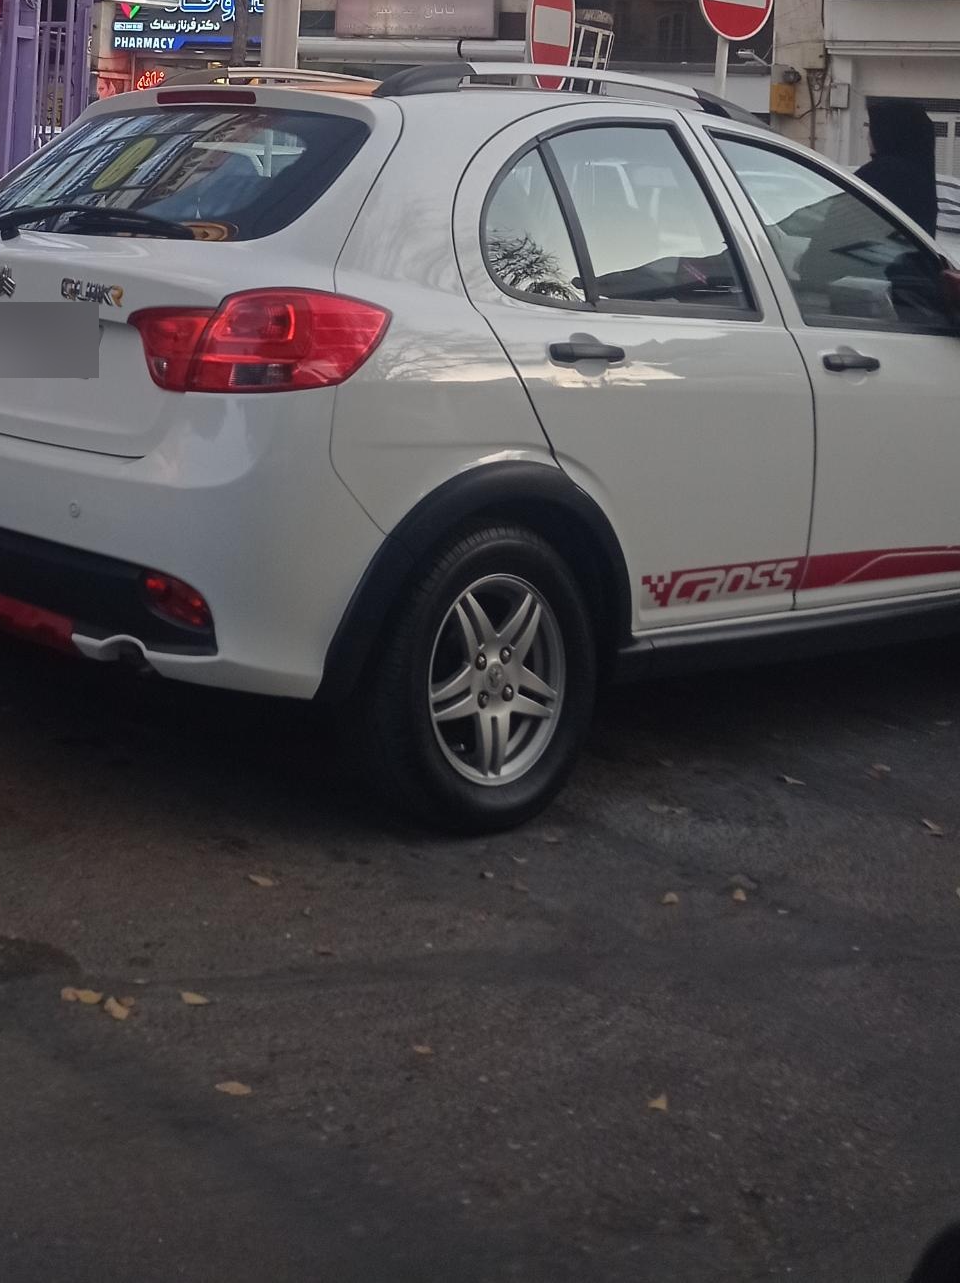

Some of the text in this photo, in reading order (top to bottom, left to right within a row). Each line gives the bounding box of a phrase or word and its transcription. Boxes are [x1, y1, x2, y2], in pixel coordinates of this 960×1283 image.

[196, 20, 220, 33] دکتر
[115, 37, 175, 49] PHARMACY
[666, 560, 798, 607] CROSS
